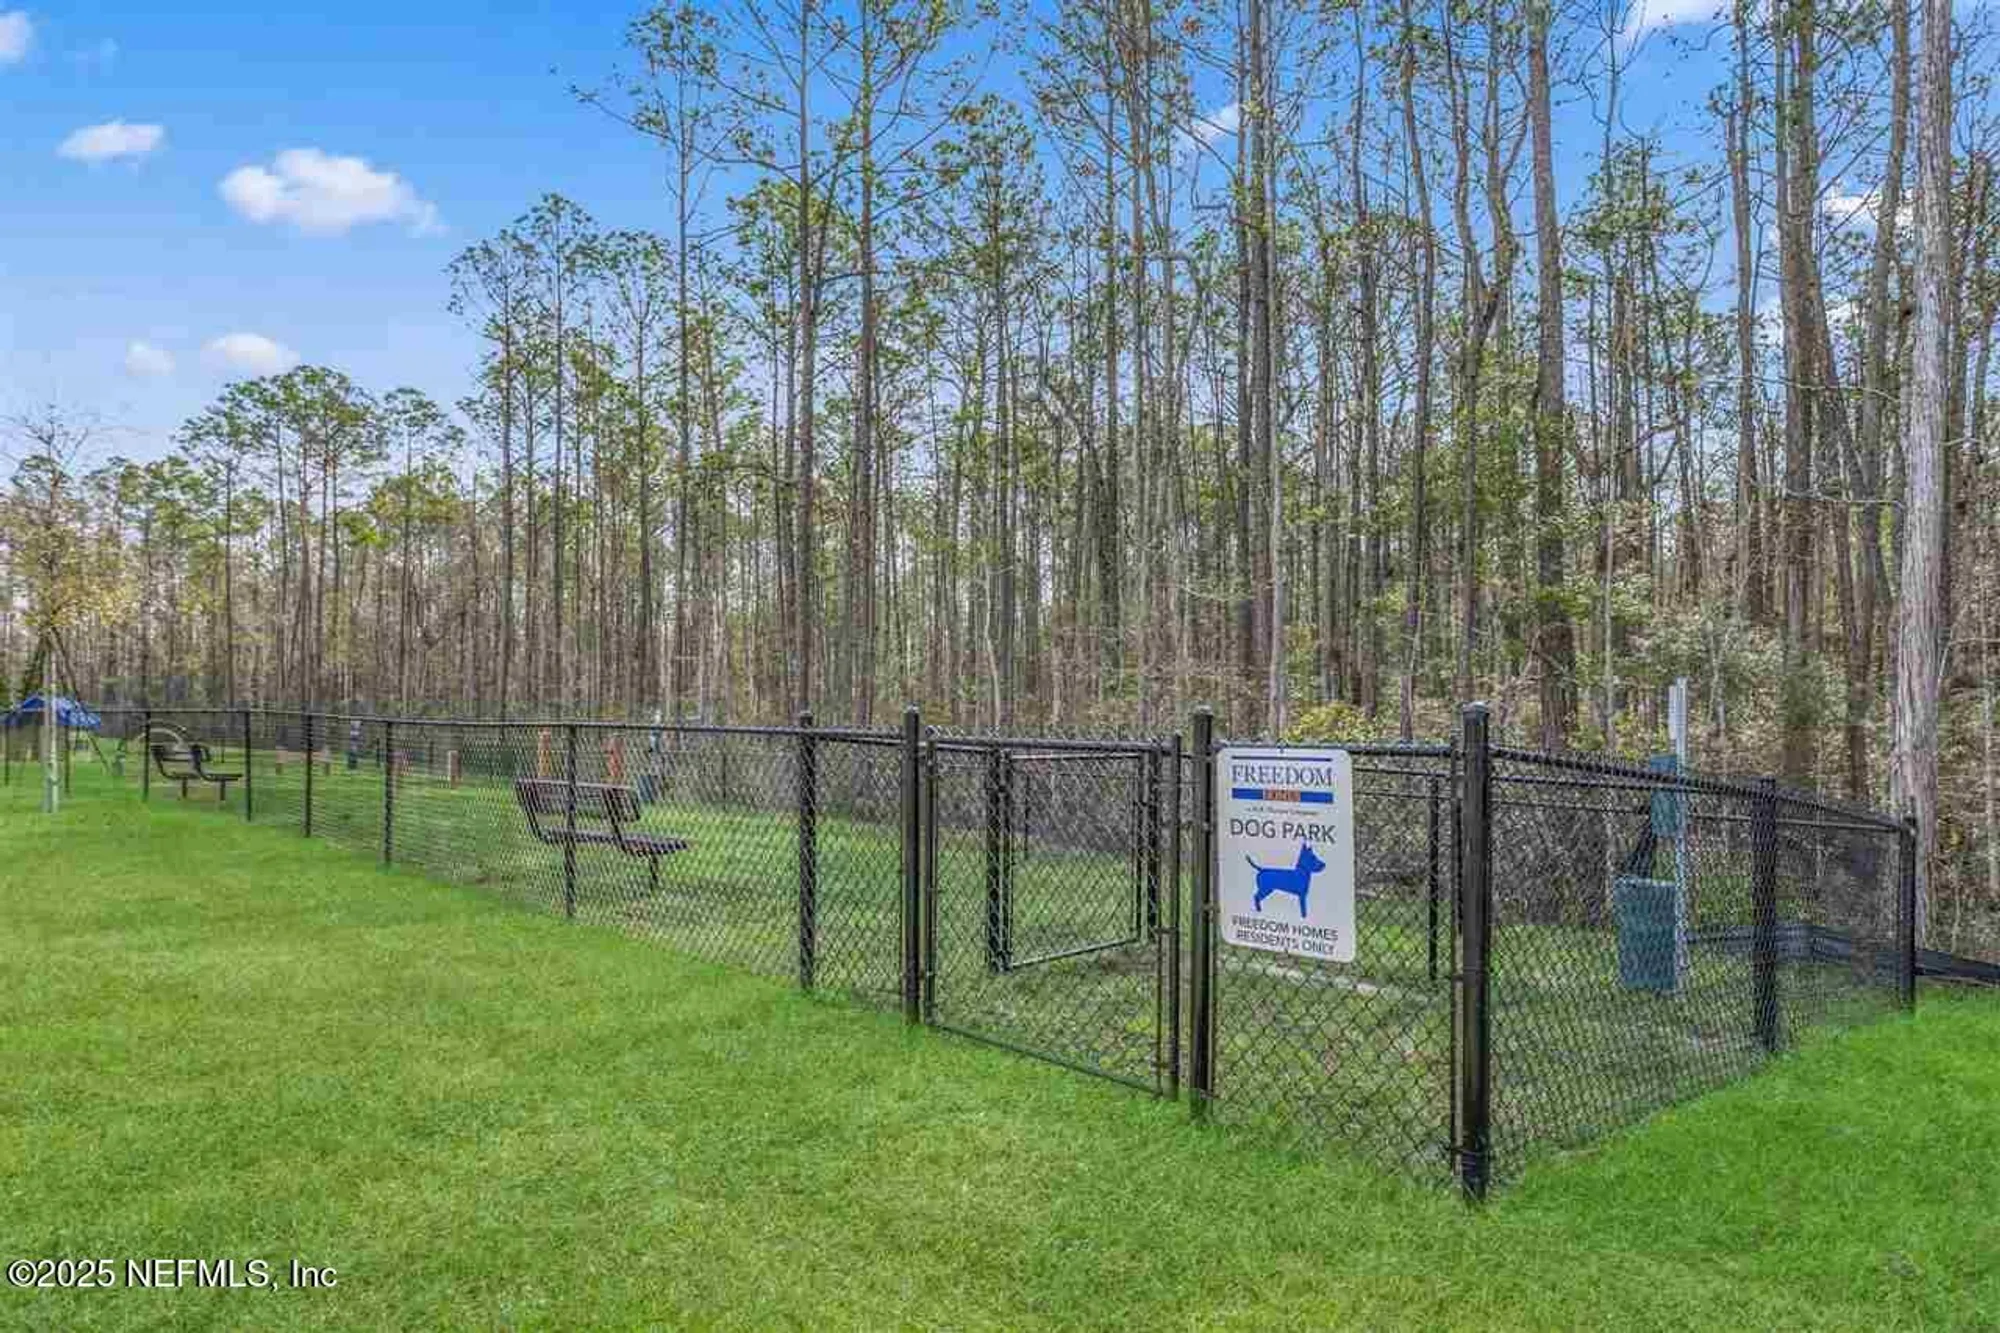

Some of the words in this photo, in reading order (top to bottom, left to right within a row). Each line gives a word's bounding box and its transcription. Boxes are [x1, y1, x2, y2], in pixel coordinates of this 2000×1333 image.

[1231, 764, 1333, 787] FREEDOM
[1230, 818, 1276, 839] DOG
[1282, 821, 1336, 844] PARK
[1232, 915, 1289, 935] FREEDOM
[1292, 925, 1339, 941] HOMES
[1236, 929, 1299, 950] RESIDENTS
[1301, 939, 1336, 956] ONLY
